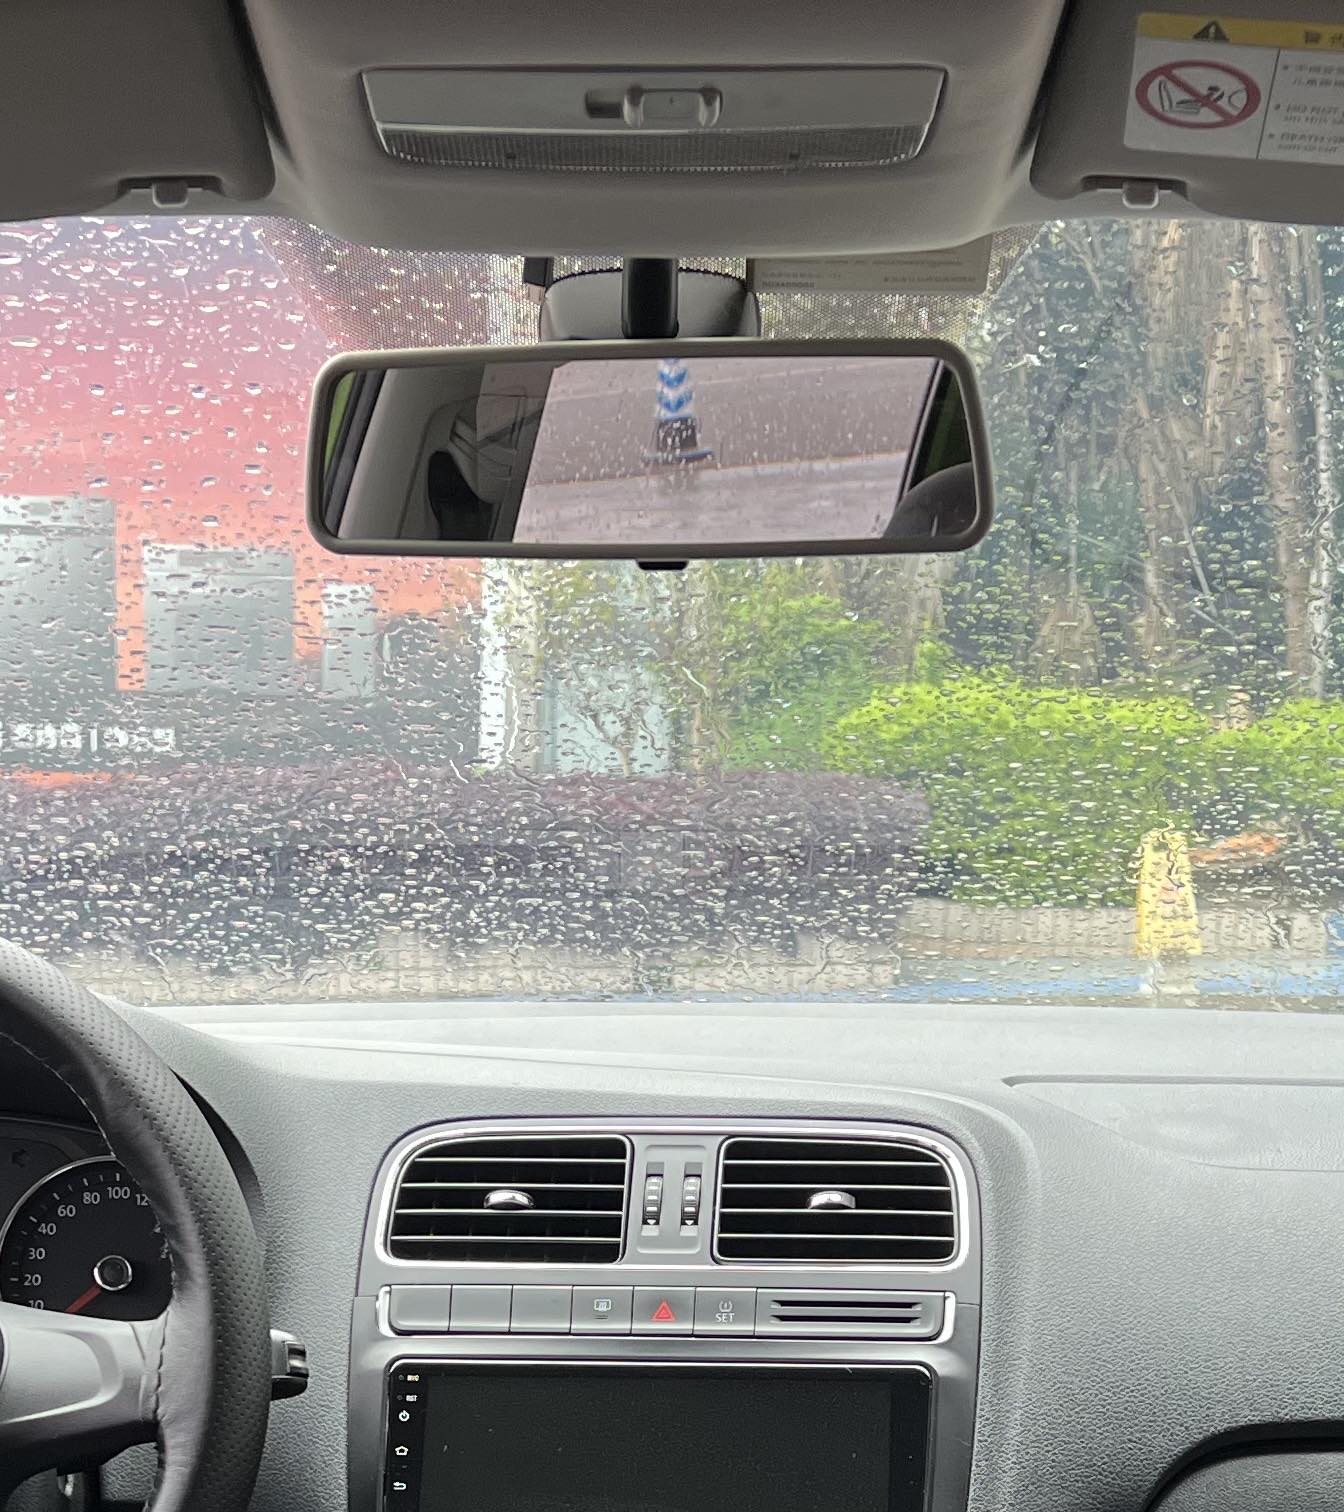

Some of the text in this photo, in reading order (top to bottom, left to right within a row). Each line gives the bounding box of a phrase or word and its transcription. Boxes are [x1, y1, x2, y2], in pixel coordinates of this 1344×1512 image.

[82, 1192, 100, 1204] 80
[106, 1186, 130, 1199] 100
[135, 1193, 149, 1206] 12
[57, 1204, 76, 1217] 60
[38, 1222, 56, 1235] 40
[28, 1247, 46, 1260] 30
[23, 1273, 42, 1286] 20
[28, 1299, 44, 1310] 10
[716, 1312, 735, 1322] SET
